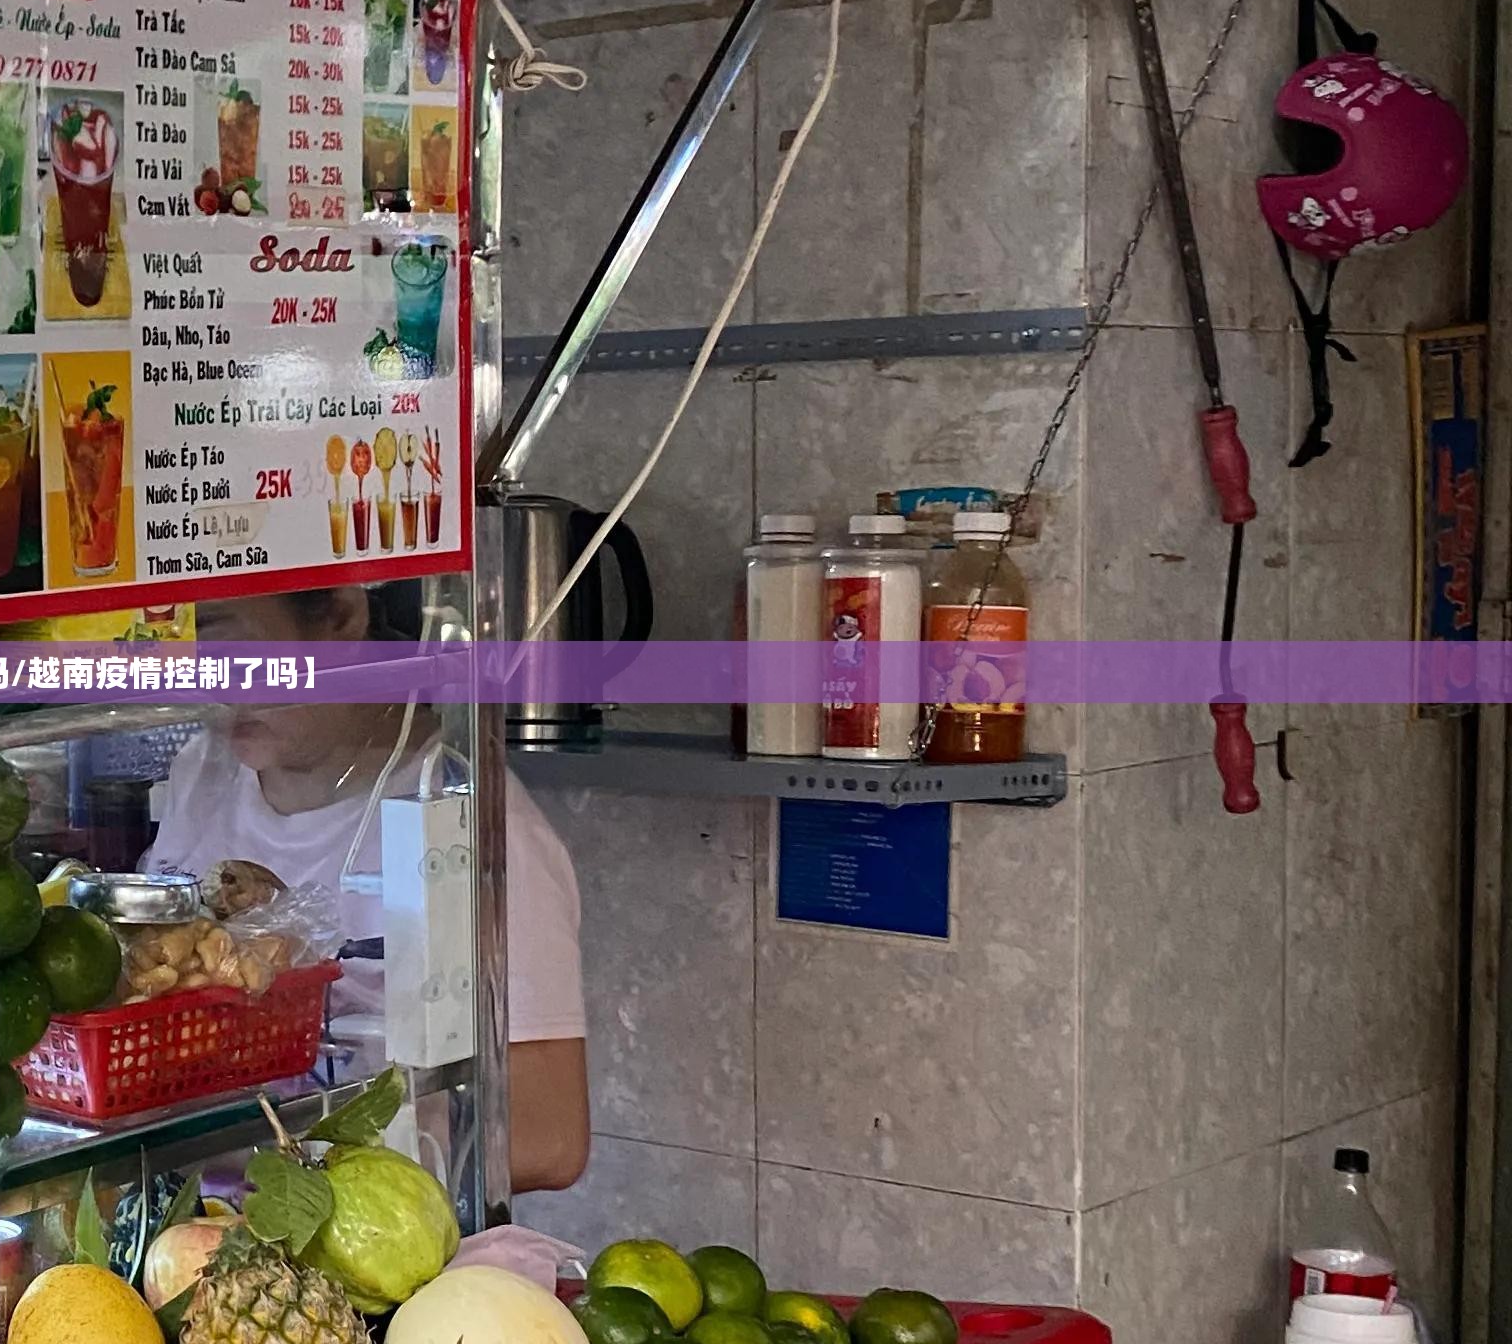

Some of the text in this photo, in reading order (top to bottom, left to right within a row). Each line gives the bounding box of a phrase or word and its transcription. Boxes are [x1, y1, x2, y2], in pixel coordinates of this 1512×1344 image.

[136, 9, 157, 32] Trà
[290, 24, 311, 44] 15k
[51, 59, 98, 82] 0871
[136, 47, 157, 68] Trà
[191, 50, 216, 73] Cam
[289, 60, 343, 81] 20k 30k
[136, 85, 187, 107] Trà Dâu
[289, 95, 344, 116] 15k 25k
[136, 121, 157, 143] Trà
[289, 130, 343, 151] 15k 25k
[136, 158, 157, 179] Trà
[289, 165, 342, 185] 15k 25k
[138, 195, 165, 216] Cam
[143, 251, 202, 277] Việt Quất
[250, 235, 355, 273] Soda
[144, 290, 175, 311] Phúc
[271, 297, 338, 325] 20K 25K
[176, 325, 204, 349] Nho,
[207, 324, 230, 345] Táo
[143, 362, 168, 386] Bạc
[197, 360, 224, 381] Blue
[174, 400, 215, 426] Nước
[221, 395, 242, 427] Ép
[319, 396, 346, 418] Các
[351, 394, 383, 421] Loại
[391, 392, 421, 414] 20K
[145, 442, 225, 470] Nước Ép Táo
[146, 484, 178, 505] Nước
[181, 477, 198, 505] Ép
[255, 468, 293, 500] 25K
[147, 520, 179, 541] Nước
[182, 513, 199, 541] Ép
[216, 549, 243, 568] Cam
